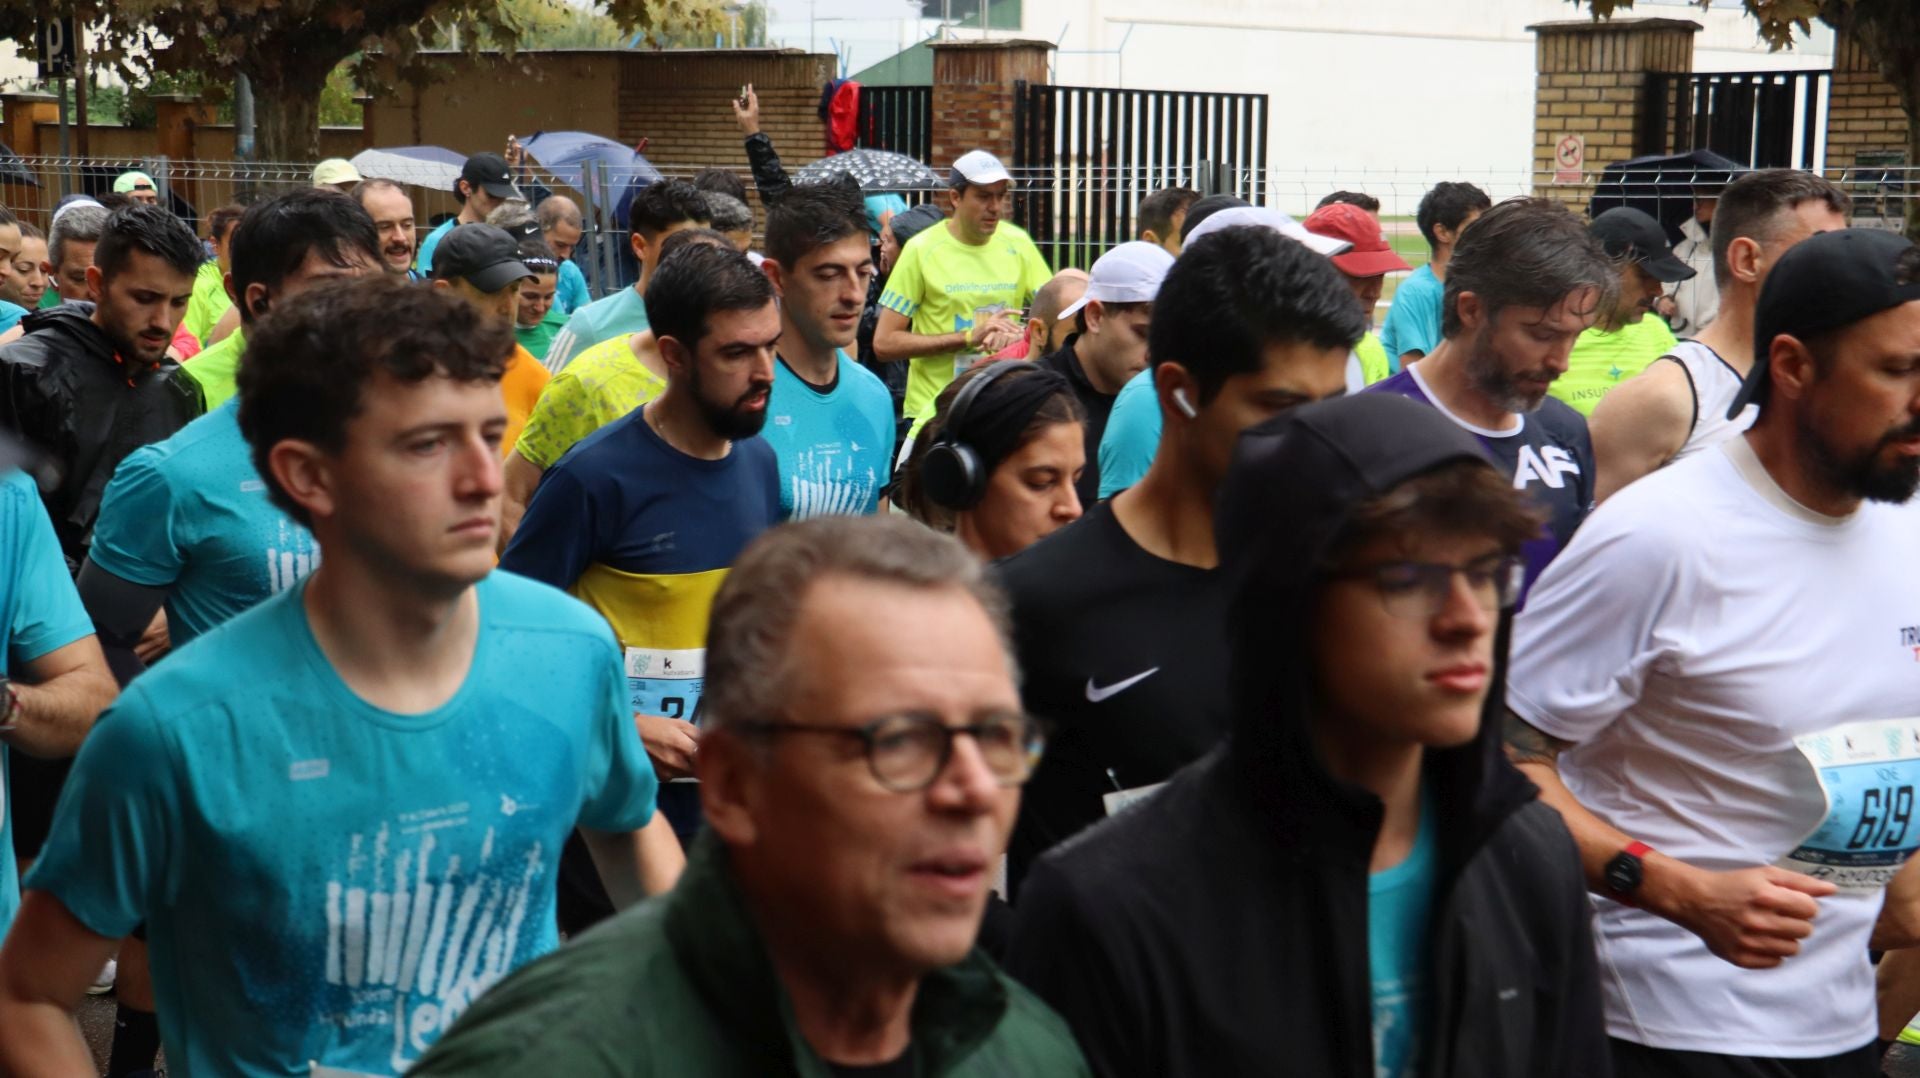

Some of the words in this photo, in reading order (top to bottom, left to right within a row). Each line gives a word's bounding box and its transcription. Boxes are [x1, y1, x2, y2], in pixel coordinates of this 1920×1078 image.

[46, 17, 64, 72] P
[1513, 444, 1581, 490] AF
[1846, 785, 1914, 850] 619
